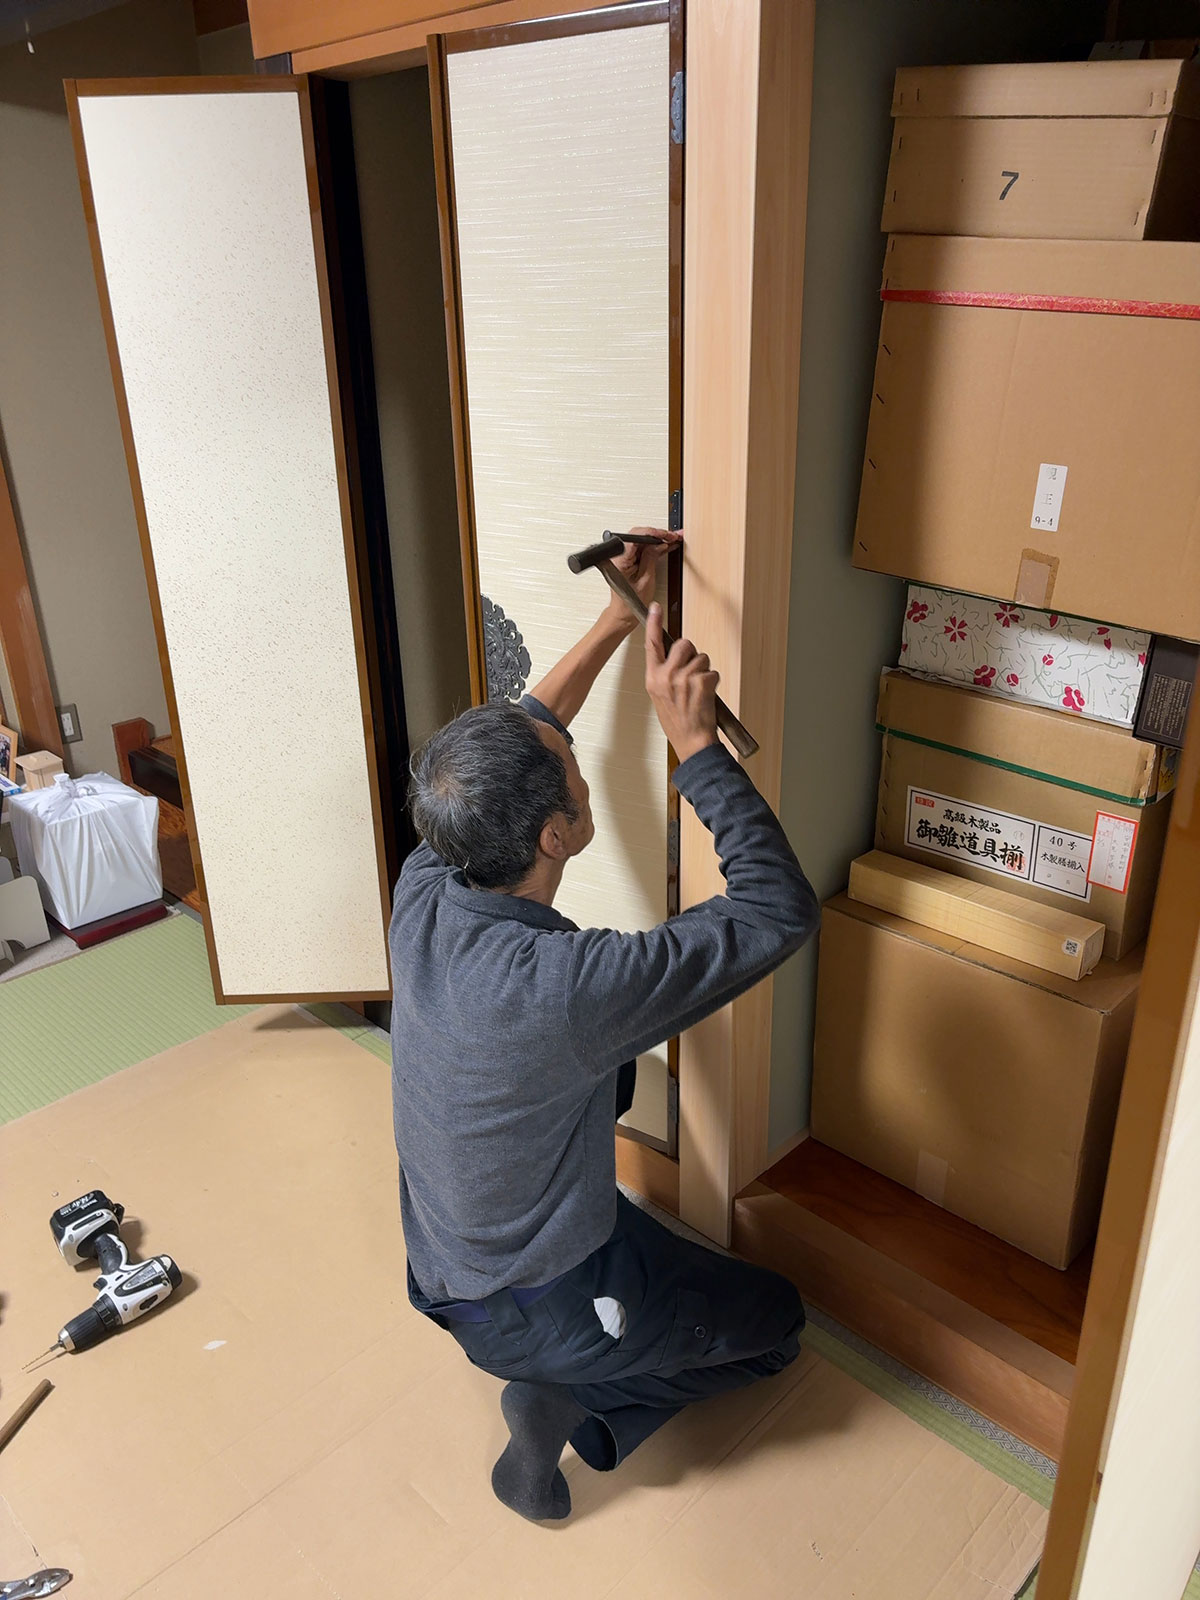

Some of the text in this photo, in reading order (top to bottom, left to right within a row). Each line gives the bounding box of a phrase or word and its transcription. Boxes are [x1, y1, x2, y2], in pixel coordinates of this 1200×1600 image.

[999, 171, 1019, 200] 7
[943, 808, 1001, 834] 高級木製品
[916, 818, 1024, 870] 御雛道具揃
